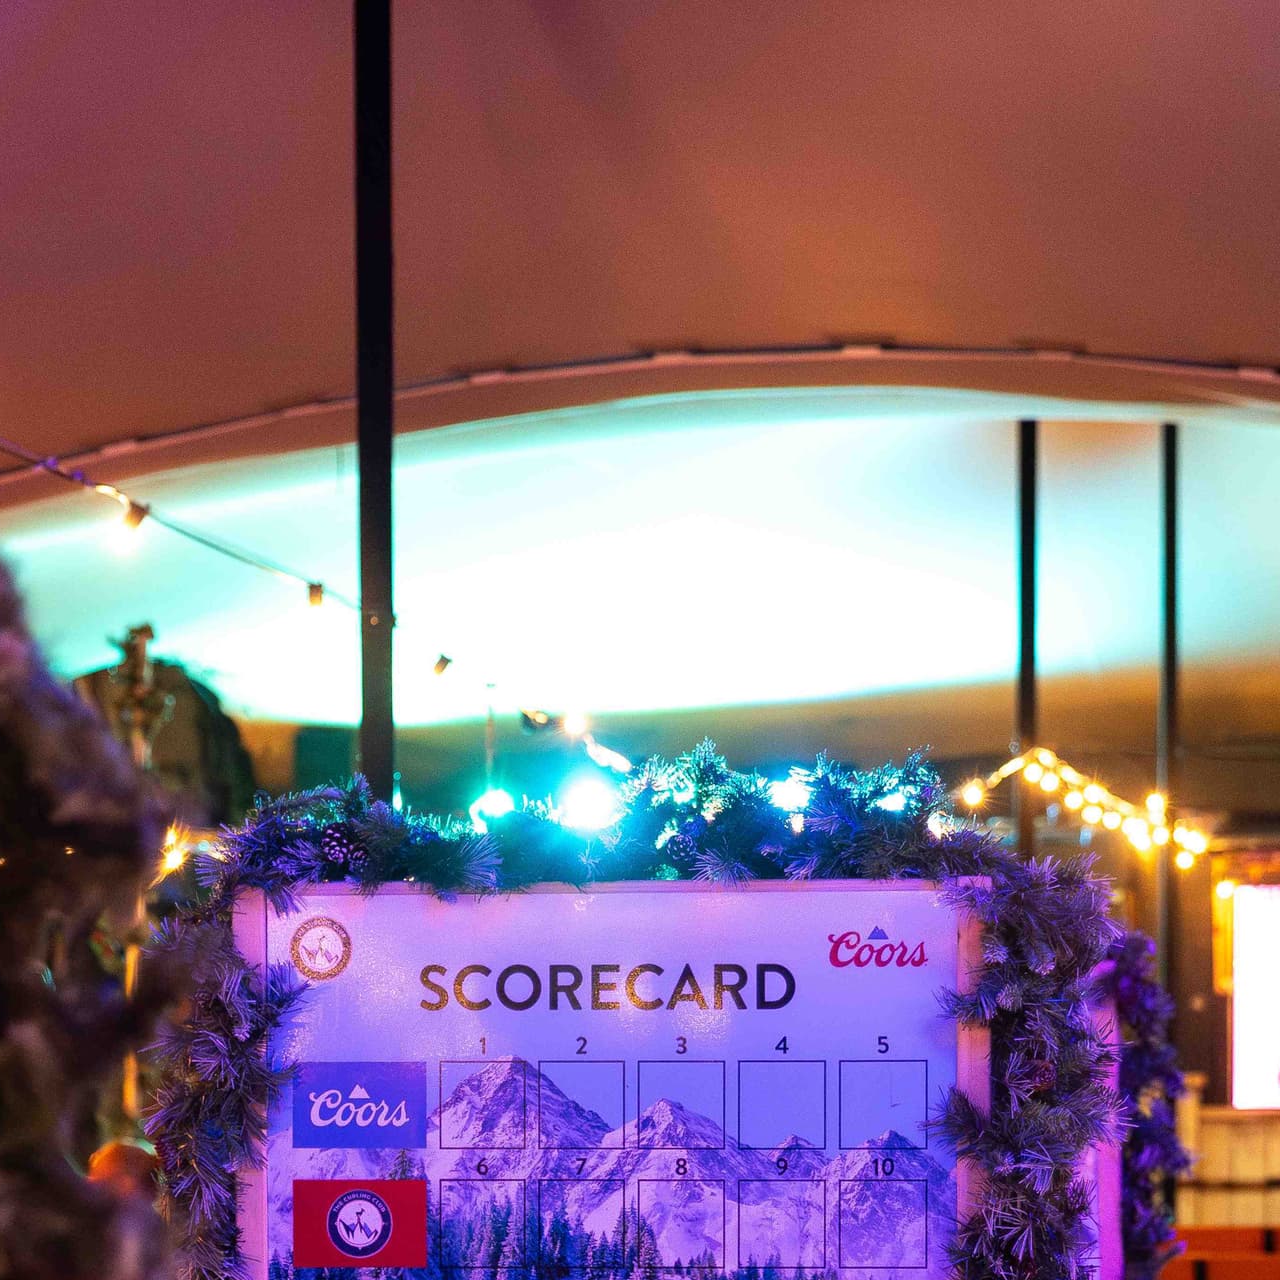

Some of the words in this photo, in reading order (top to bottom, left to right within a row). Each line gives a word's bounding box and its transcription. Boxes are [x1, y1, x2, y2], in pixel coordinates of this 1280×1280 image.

[827, 930, 929, 968] Coors
[419, 962, 797, 1012] SCORECARD
[479, 1036, 487, 1055] 1
[575, 1036, 588, 1055] 2
[676, 1036, 688, 1055] 3
[774, 1035, 790, 1054] 4
[877, 1035, 889, 1054] 5
[308, 1088, 410, 1128] Coors
[476, 1157, 489, 1176] 6
[575, 1157, 587, 1176] 7
[675, 1157, 688, 1176] 8
[776, 1157, 789, 1176] 9
[871, 1157, 895, 1176] 10
